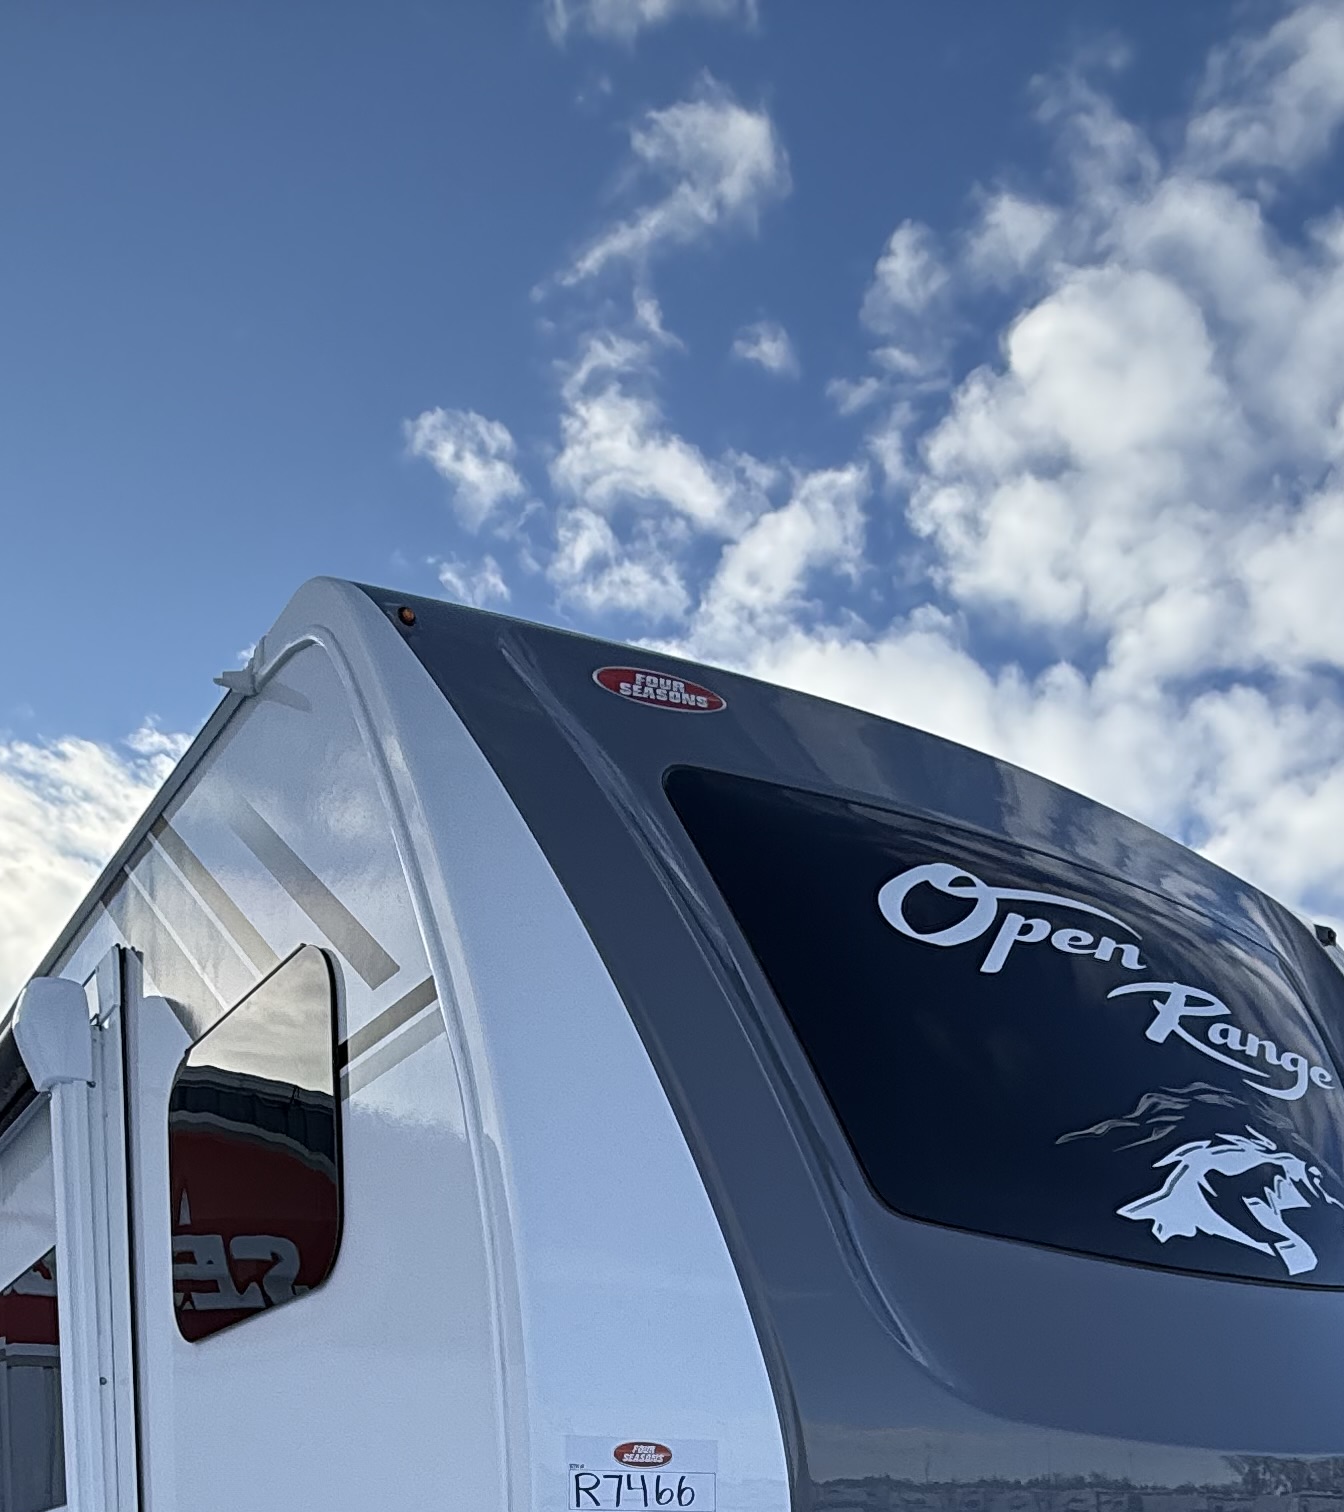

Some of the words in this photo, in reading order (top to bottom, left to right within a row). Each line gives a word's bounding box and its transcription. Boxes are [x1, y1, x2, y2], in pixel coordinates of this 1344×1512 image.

[619, 682, 708, 708] SEASONS
[635, 673, 685, 693] FOUR
[877, 862, 1146, 973] Open
[1106, 982, 1335, 1100] Range
[622, 1453, 664, 1462] SEASONS
[632, 1445, 656, 1453] FOUR
[574, 1473, 695, 1508] R7466
